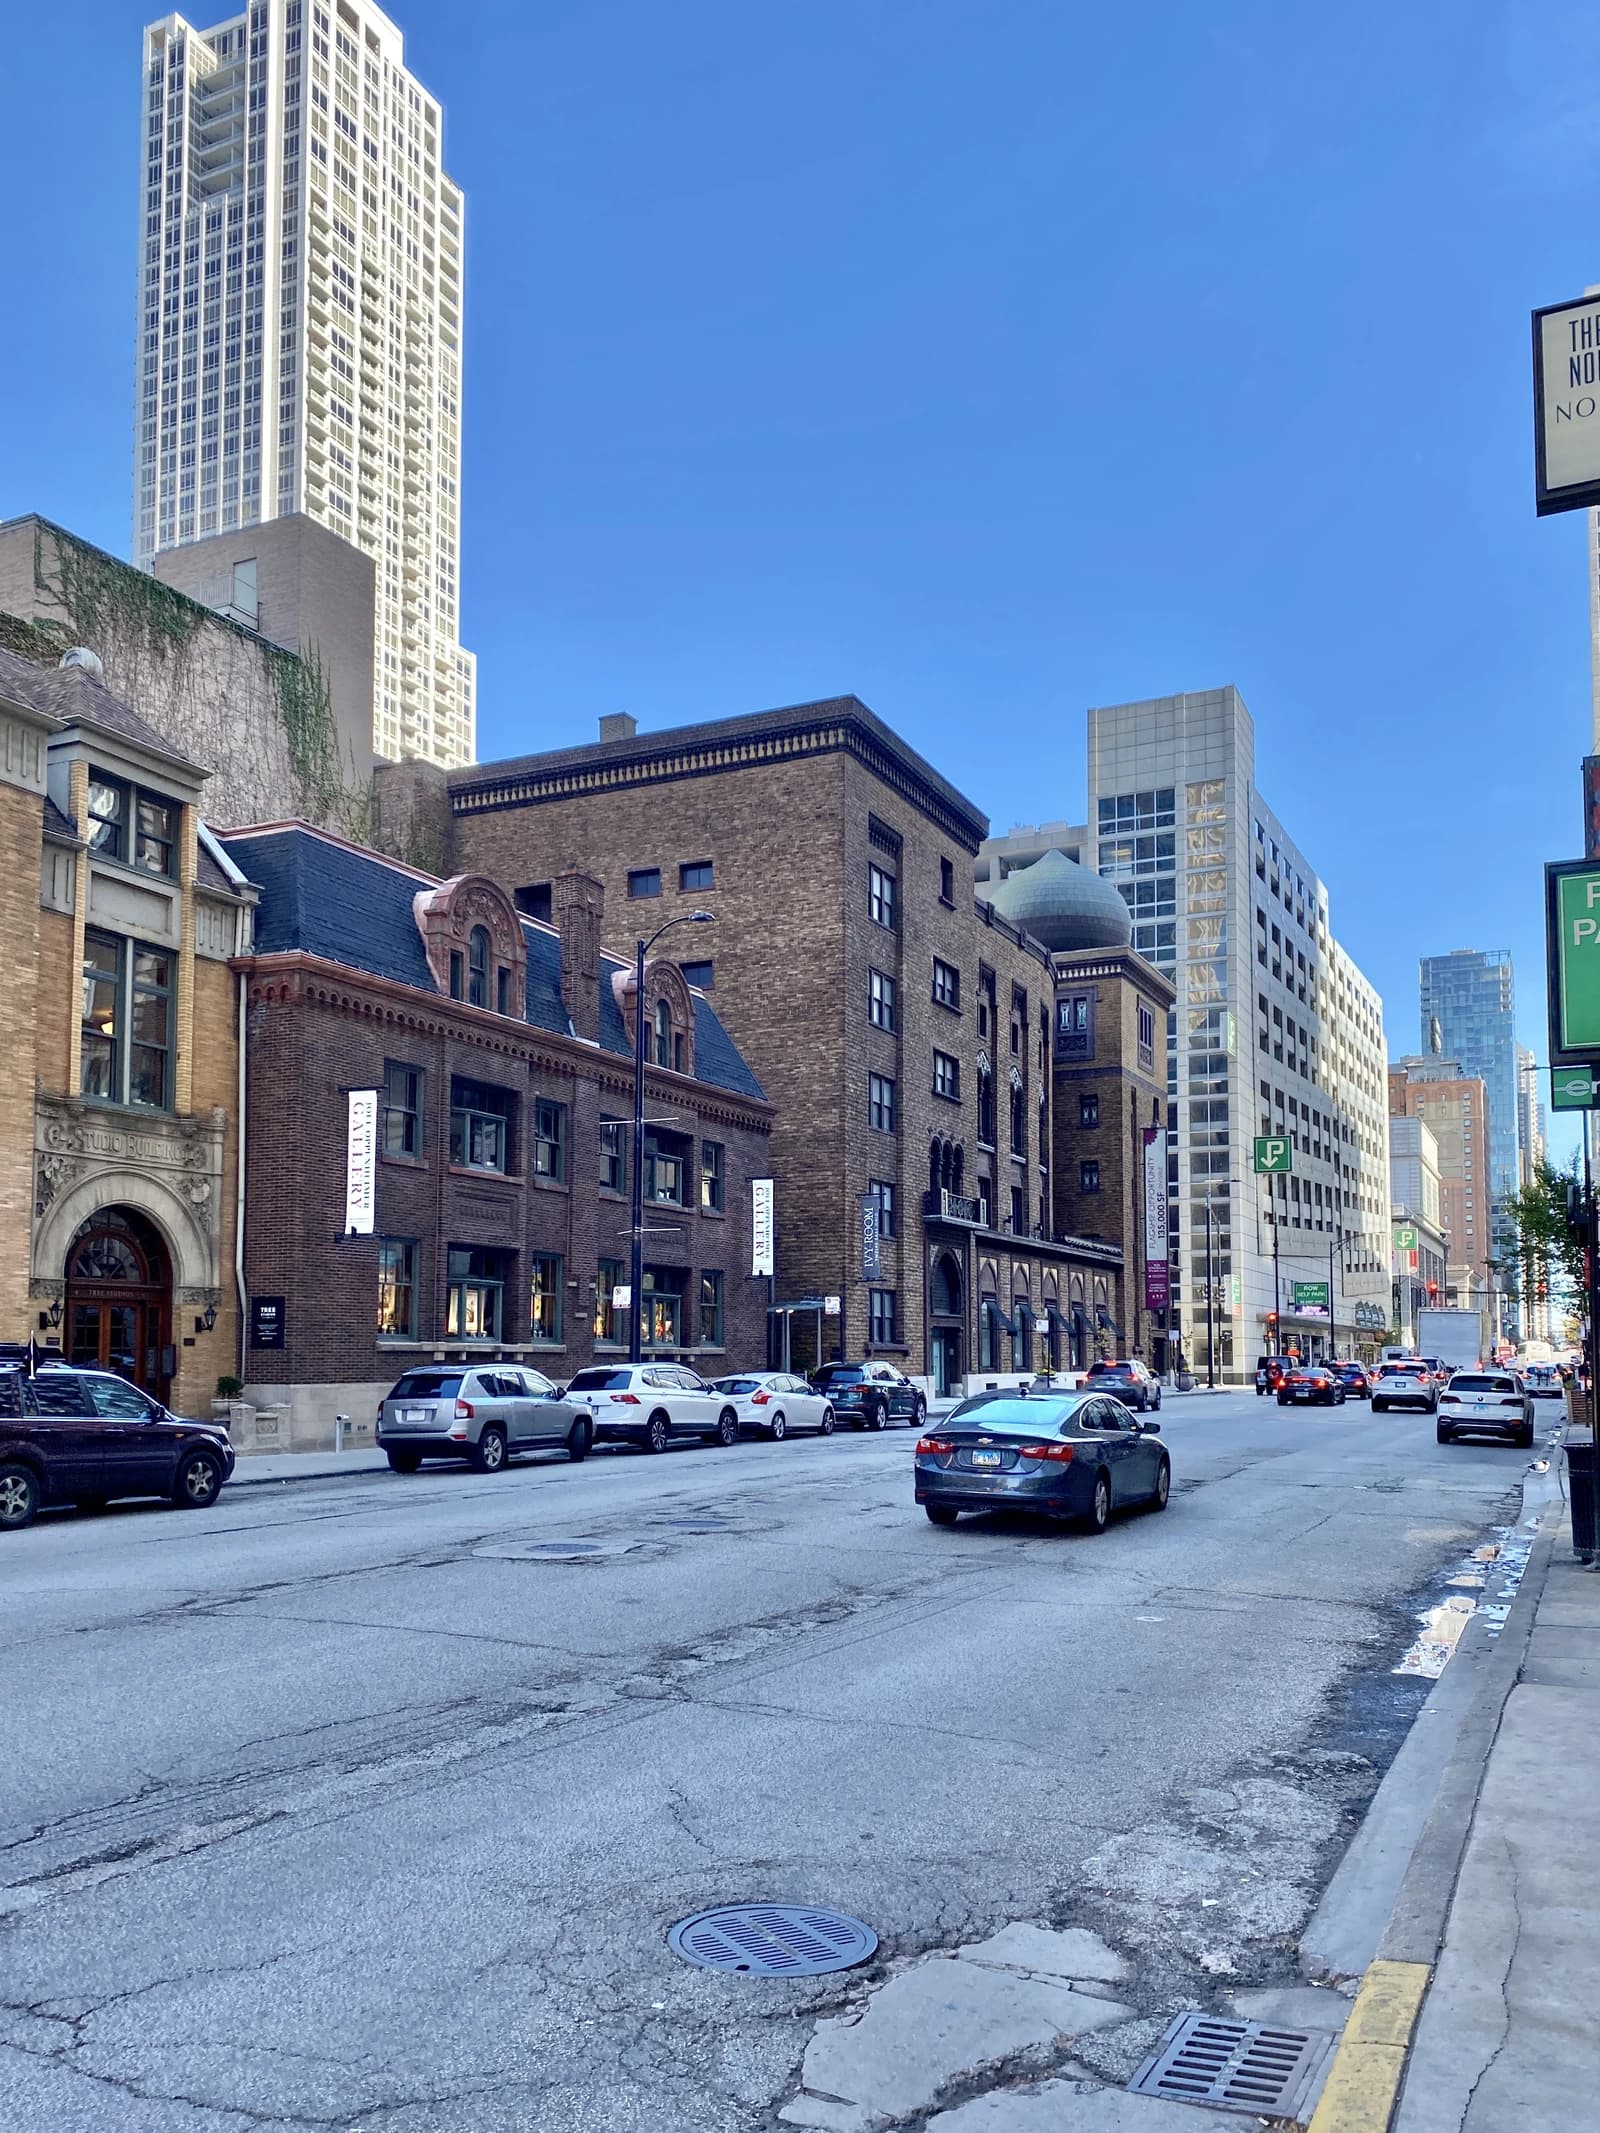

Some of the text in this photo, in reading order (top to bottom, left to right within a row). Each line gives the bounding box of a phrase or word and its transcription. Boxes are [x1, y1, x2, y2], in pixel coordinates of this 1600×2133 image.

[75, 1126, 186, 1161] STUDIO BUILDING
[351, 1102, 364, 1209] GALLERY
[1147, 1157, 1156, 1212] OPPORTUNITY
[756, 1187, 764, 1259] GALLERY
[863, 1207, 874, 1267] IVY ROOM
[1157, 1191, 1166, 1239] 135,000 SF
